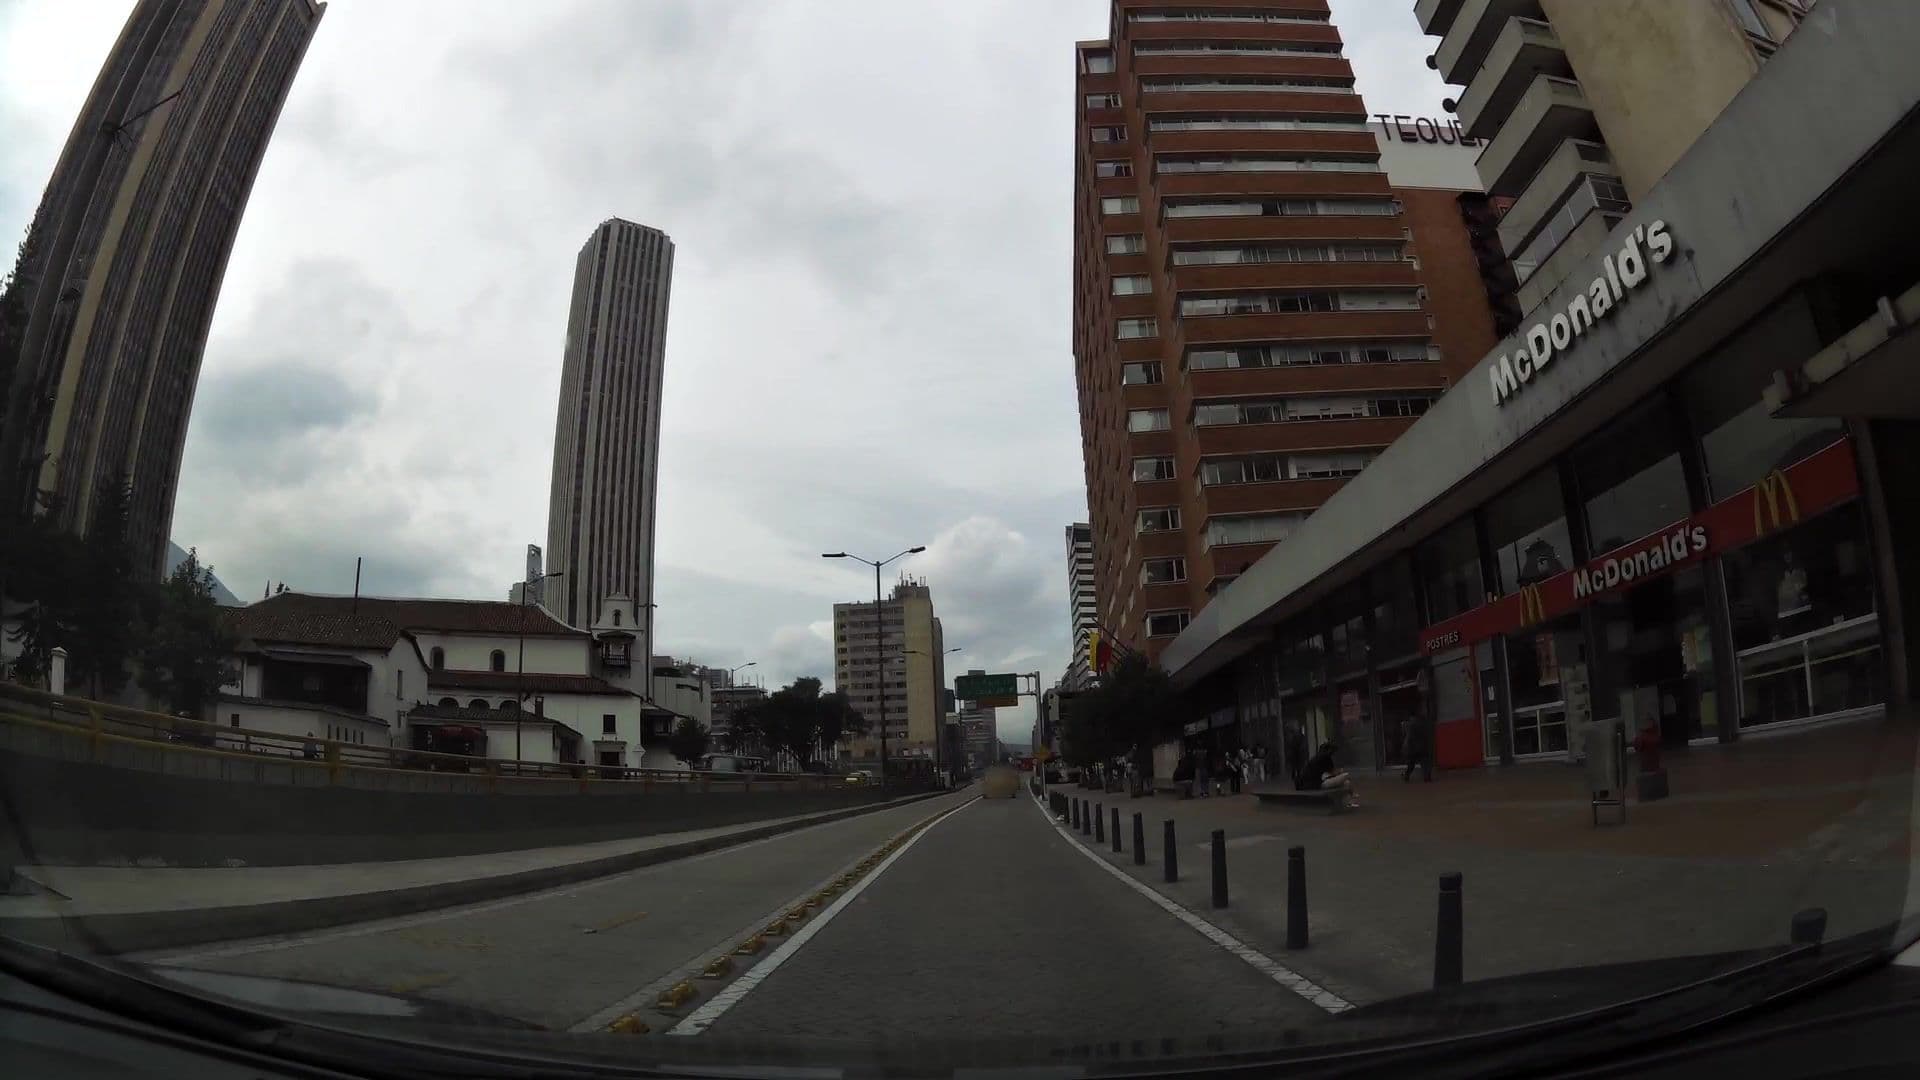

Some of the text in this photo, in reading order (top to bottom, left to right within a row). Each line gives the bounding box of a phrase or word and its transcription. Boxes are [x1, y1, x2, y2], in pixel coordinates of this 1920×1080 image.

[1374, 114, 1484, 147] TEQUE
[1489, 218, 1673, 406] McDonald's
[1572, 524, 1708, 600] McDonald's
[1425, 631, 1460, 649] POSTRES
